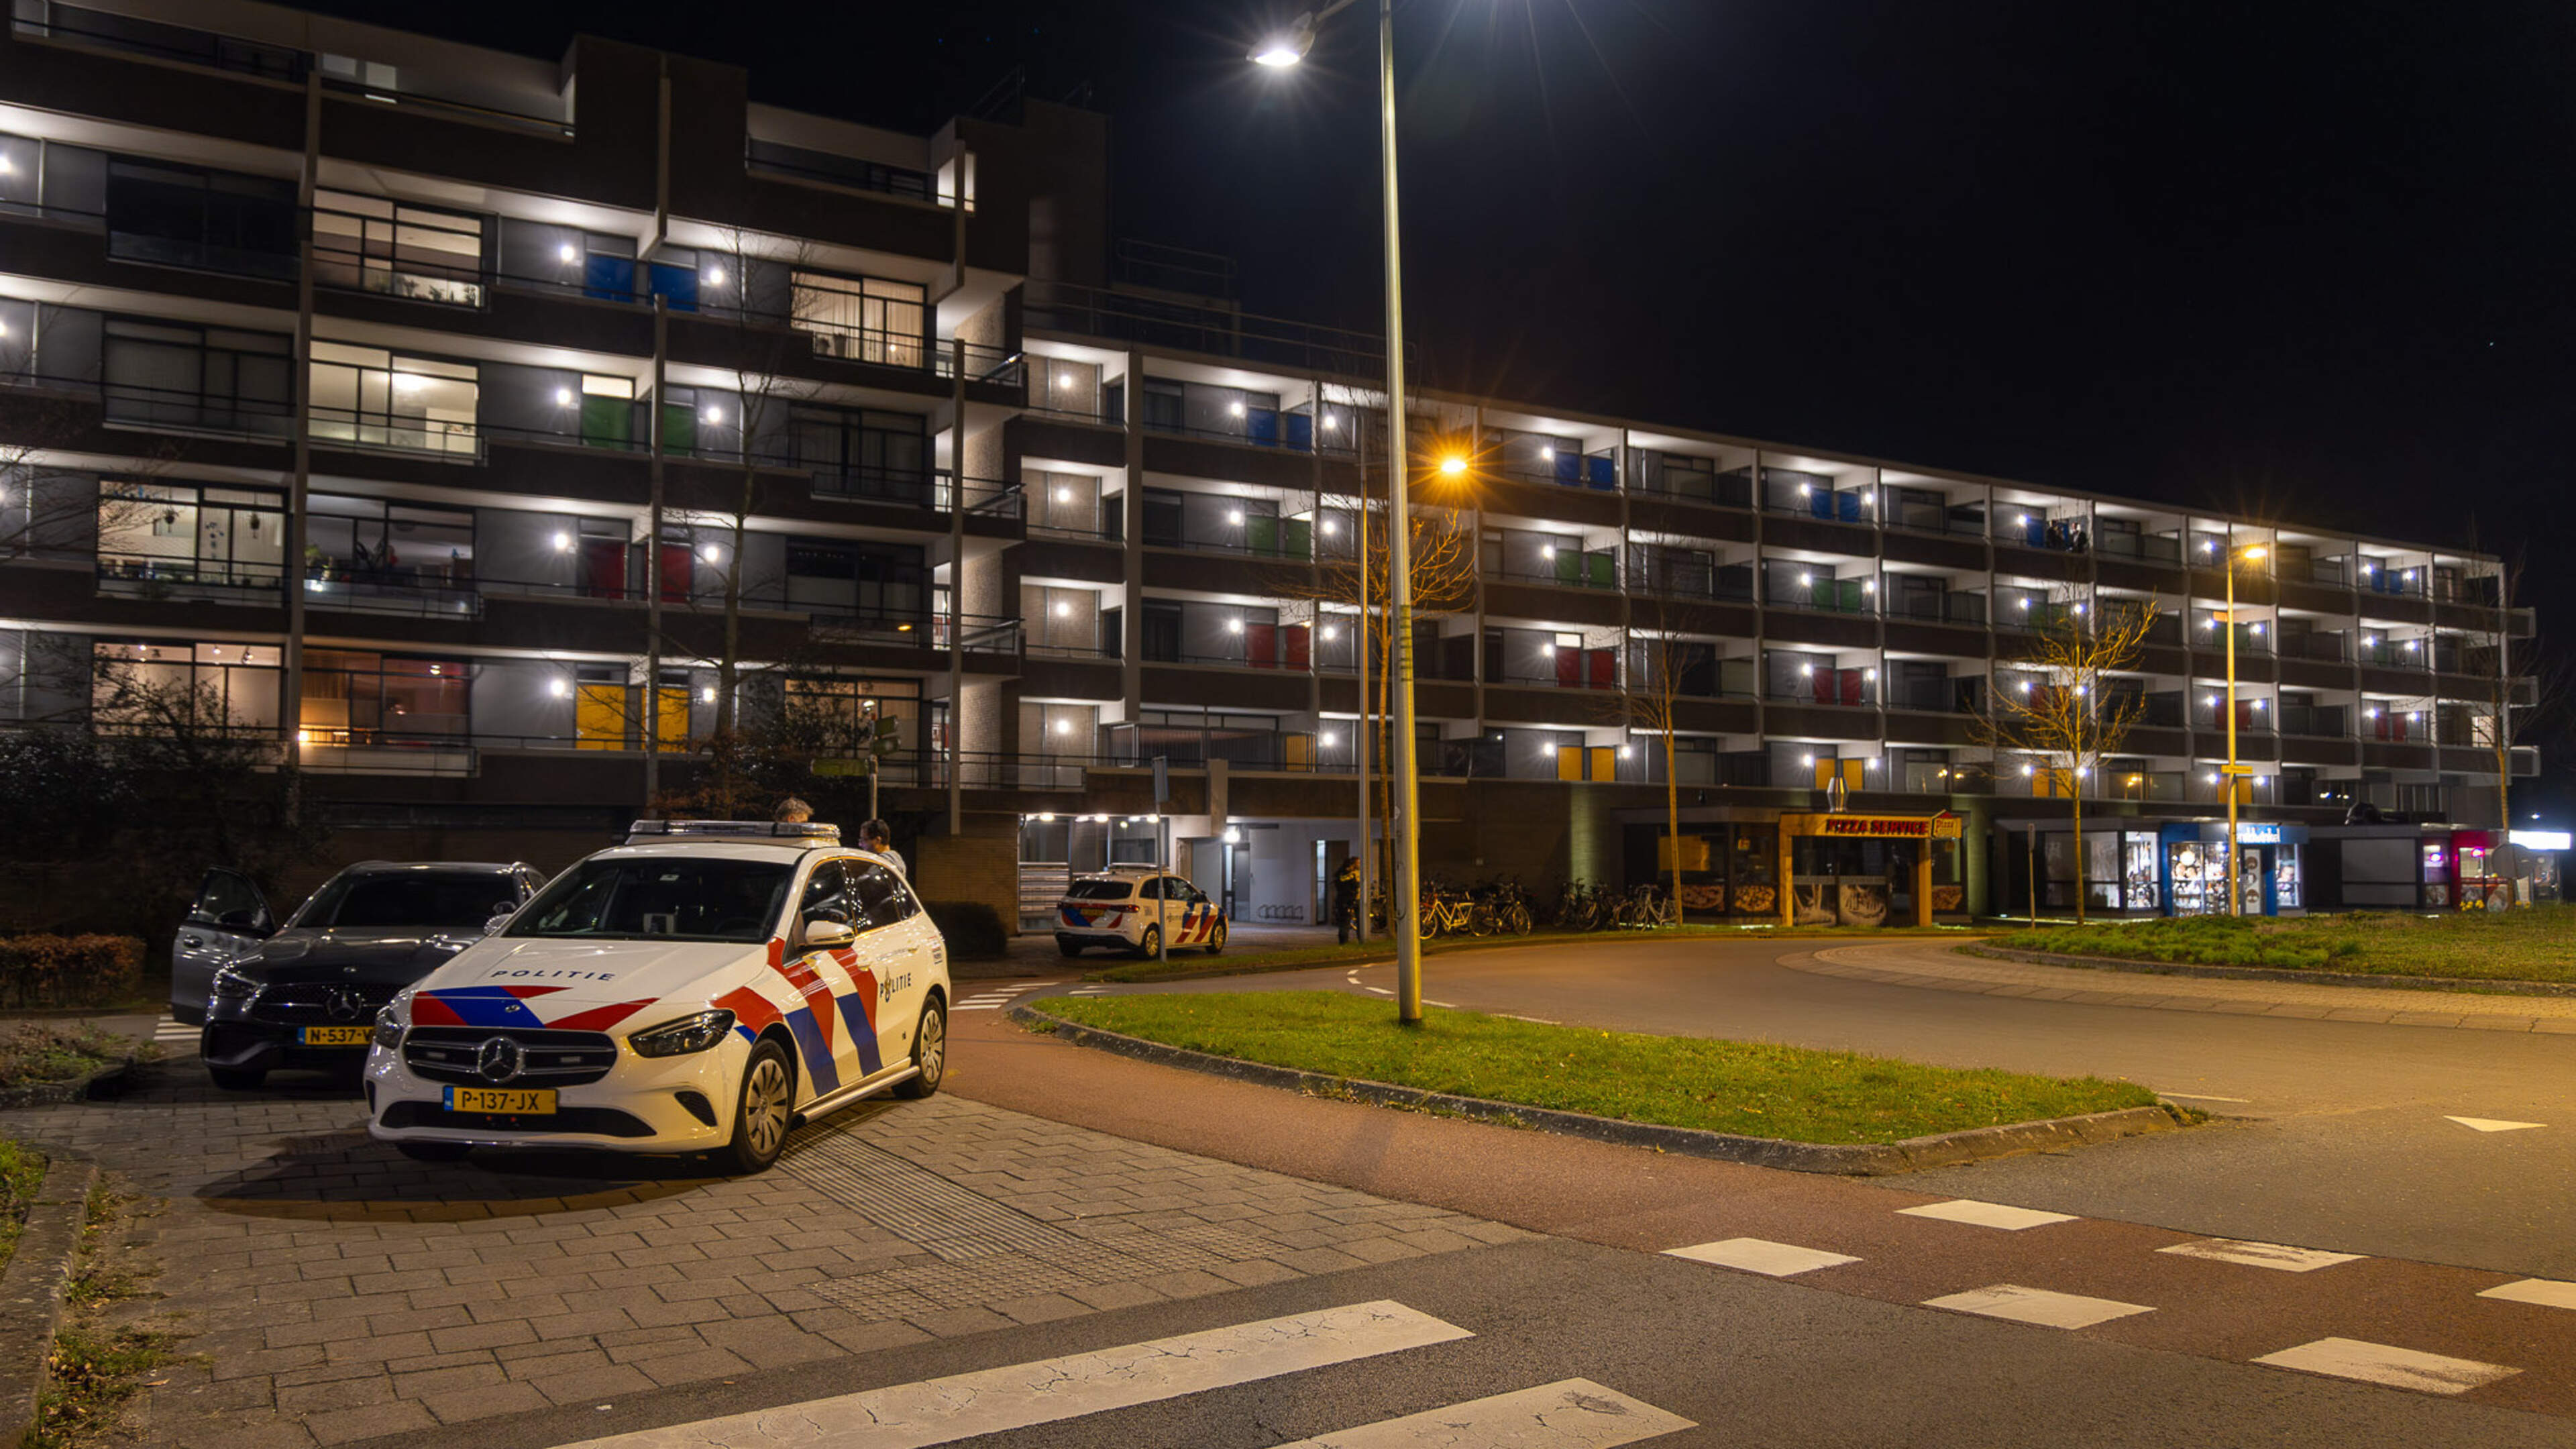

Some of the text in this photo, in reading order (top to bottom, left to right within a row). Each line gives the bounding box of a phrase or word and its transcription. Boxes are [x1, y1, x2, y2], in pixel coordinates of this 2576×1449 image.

[1826, 819, 1929, 835] PIZZA SERVICE
[490, 970, 615, 981] POLITIE
[462, 1091, 539, 1110] P-137-JX
